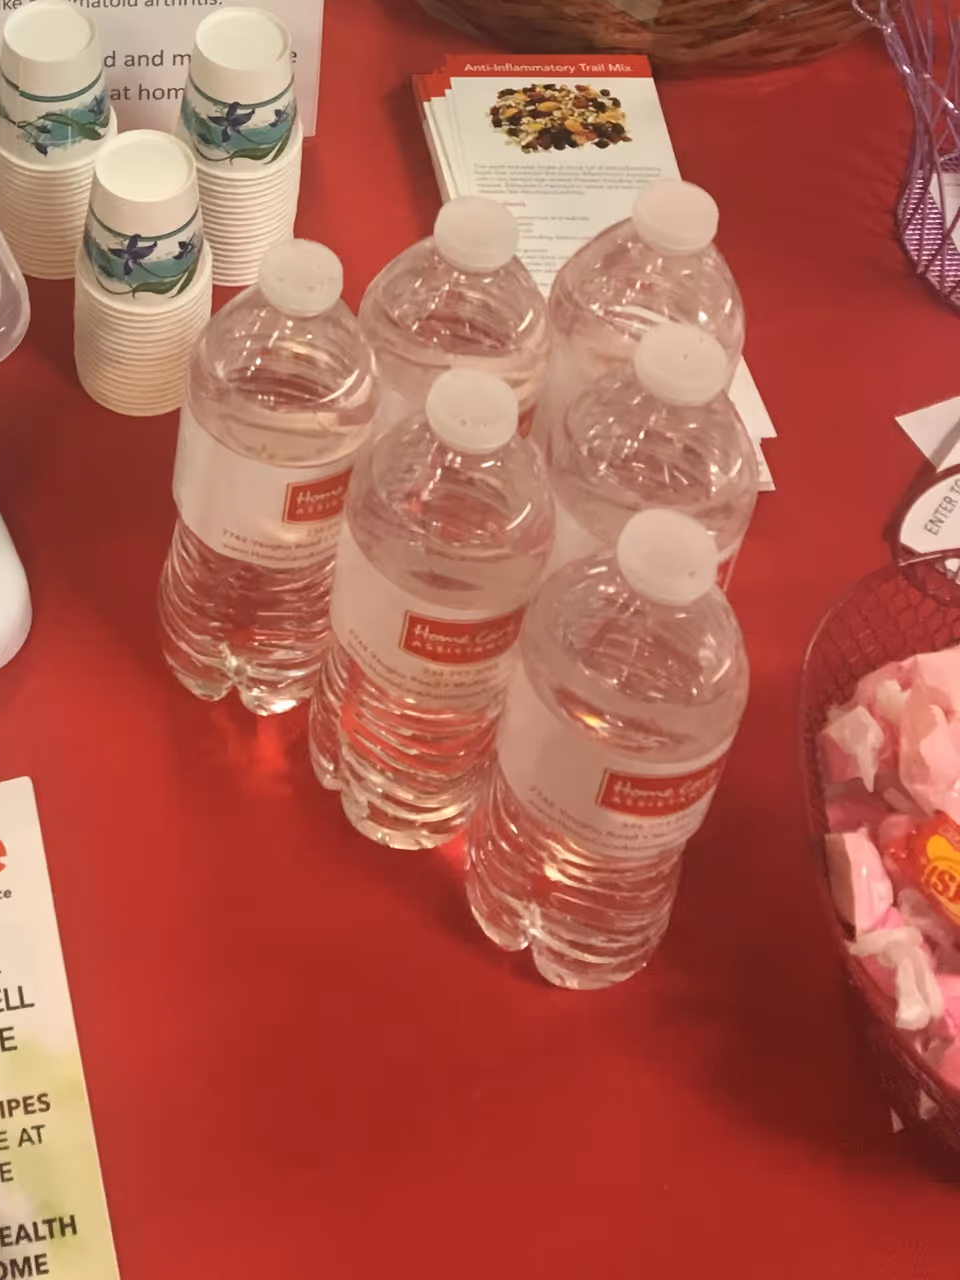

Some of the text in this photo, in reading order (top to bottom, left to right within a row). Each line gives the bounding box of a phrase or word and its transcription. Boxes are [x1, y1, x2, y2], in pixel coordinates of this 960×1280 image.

[124, 49, 164, 67] and
[464, 63, 632, 74] Anti-Inflammatory Trail Mix
[110, 86, 131, 101] at
[924, 495, 958, 536] ENTER
[414, 624, 470, 644] Home
[18, 1124, 45, 1147] AT
